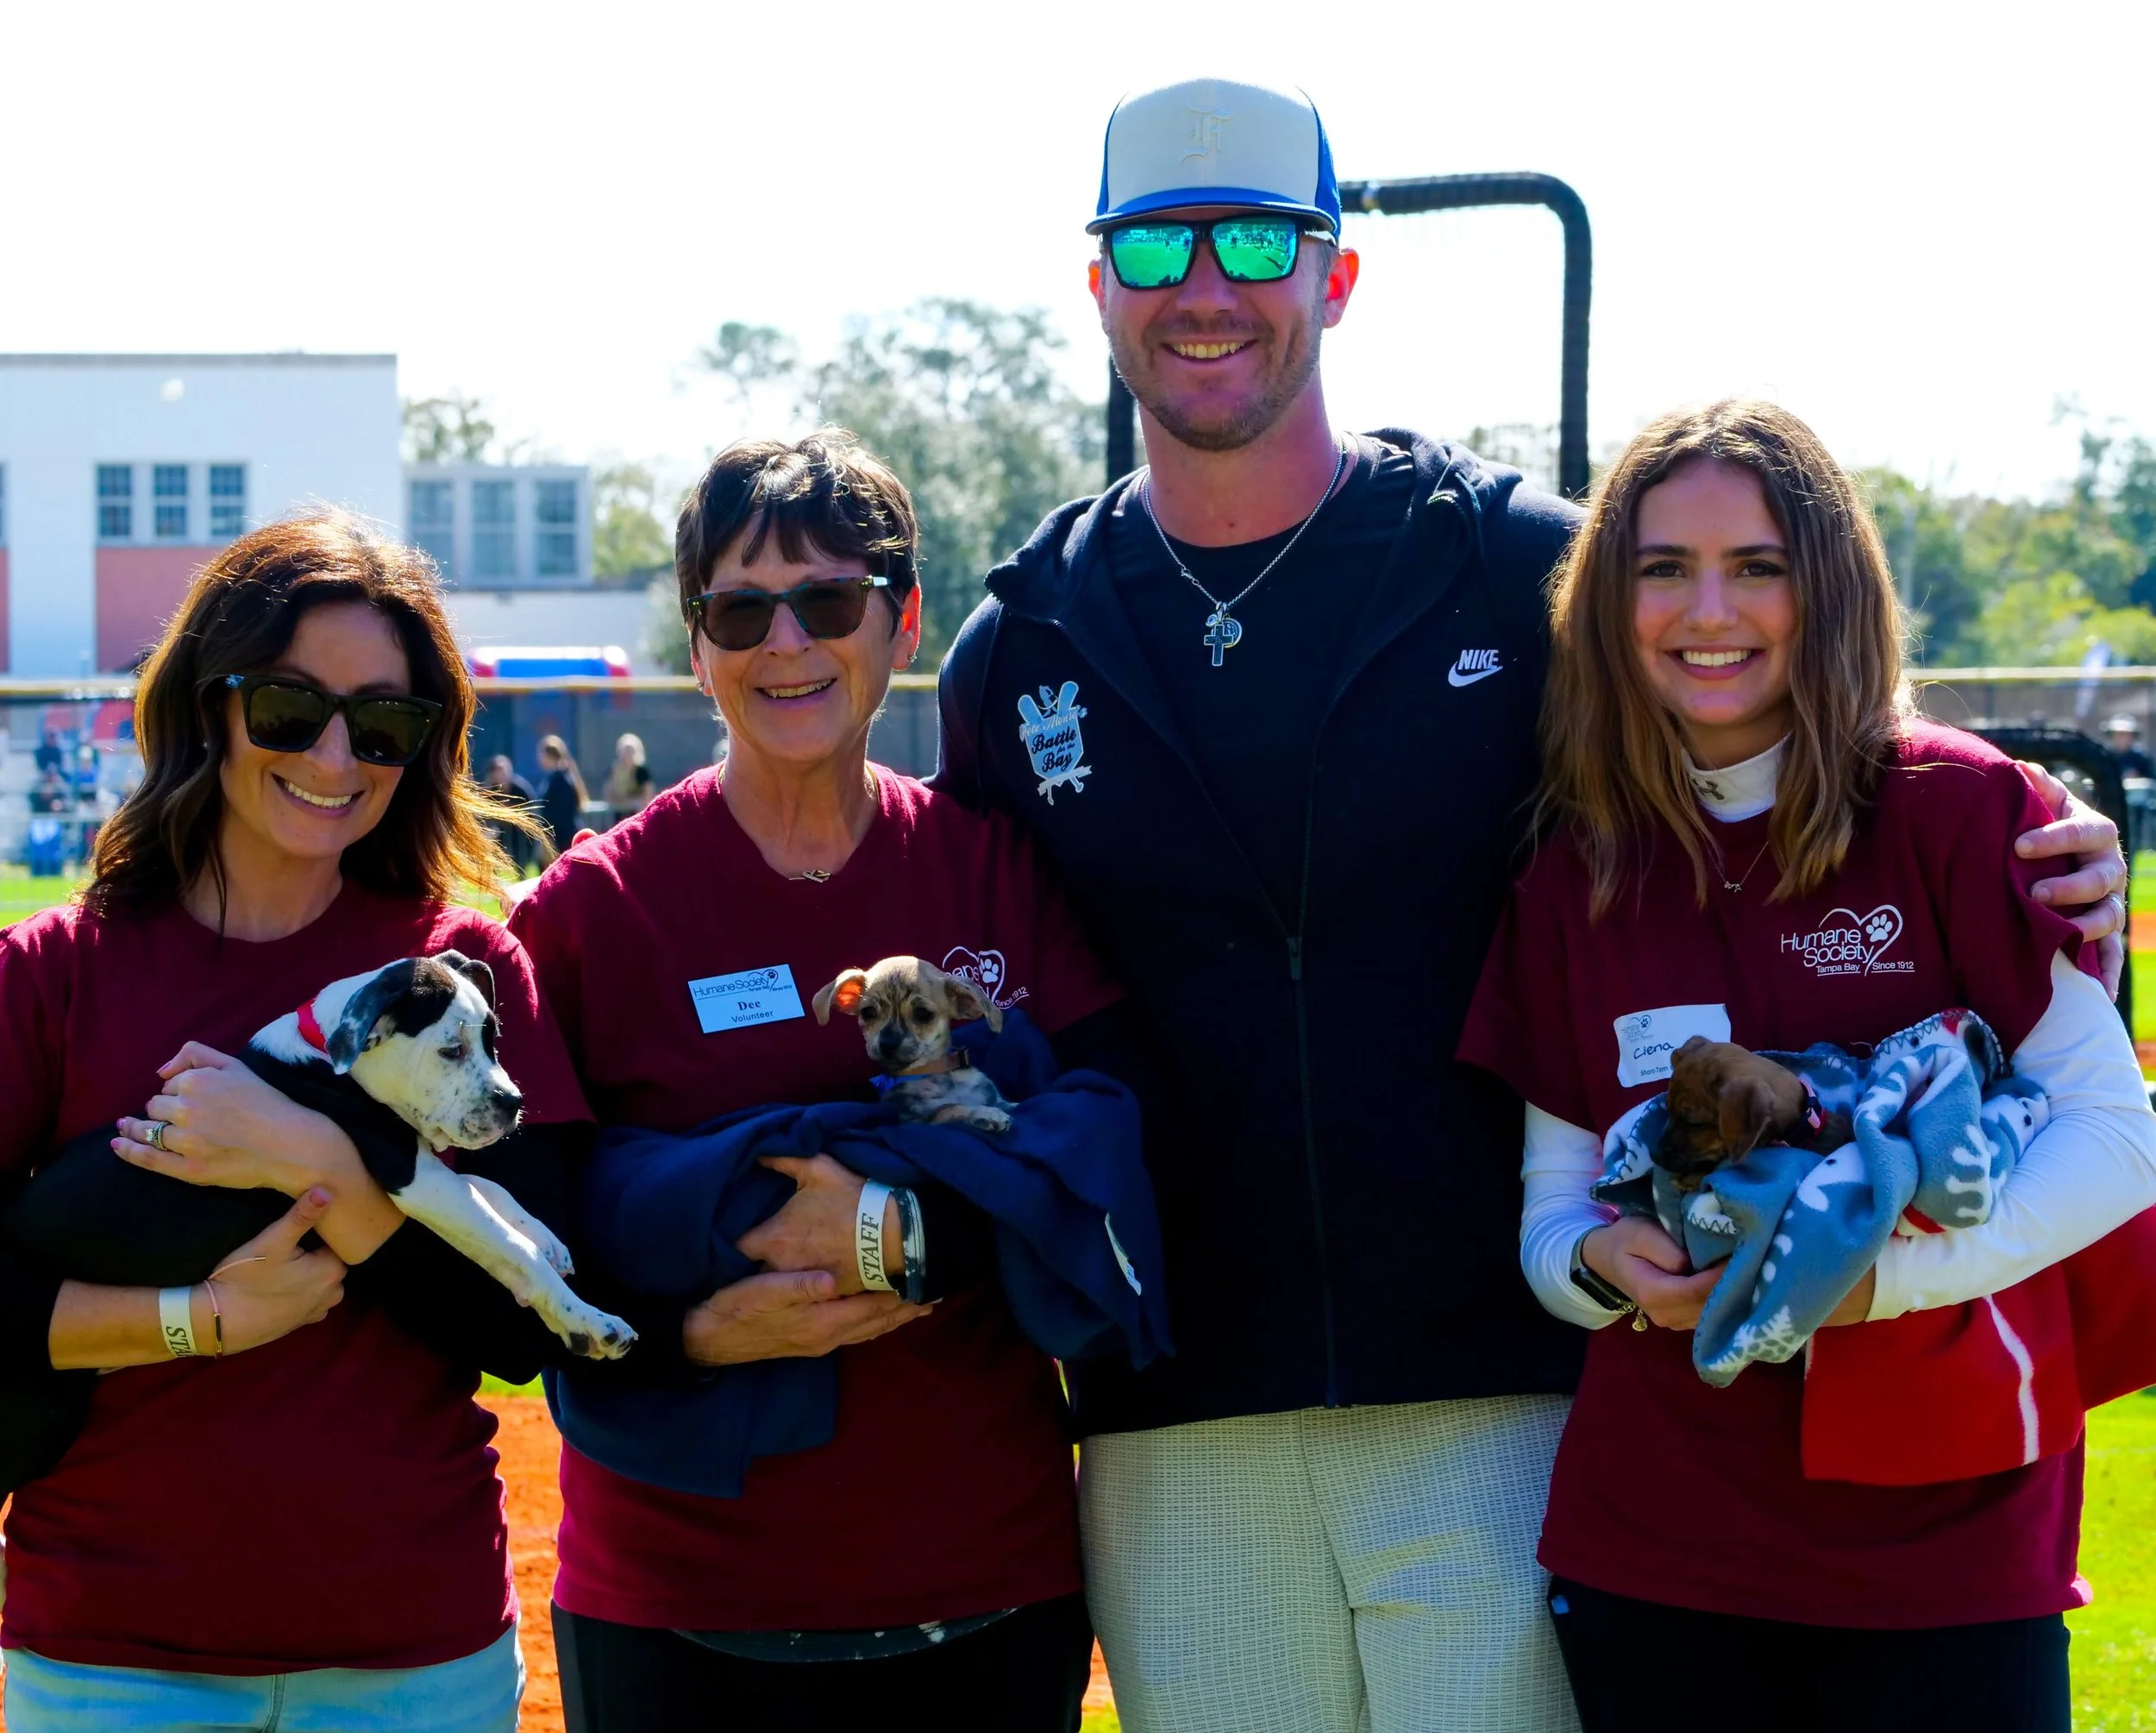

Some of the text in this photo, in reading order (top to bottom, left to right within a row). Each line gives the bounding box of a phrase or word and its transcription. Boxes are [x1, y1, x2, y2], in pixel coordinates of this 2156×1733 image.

[1457, 649, 1499, 670] NIKE
[1031, 726, 1076, 755] Battle
[1042, 751, 1073, 773] Bay
[1781, 928, 1861, 953] Humane
[1803, 940, 1875, 967] Society
[1816, 961, 1914, 974] Tampa Bay Since 1912
[1012, 986, 1028, 999] 1912
[731, 1010, 774, 1022] Volunteer
[737, 1001, 761, 1011] Dee
[861, 1212, 884, 1283] STAFF
